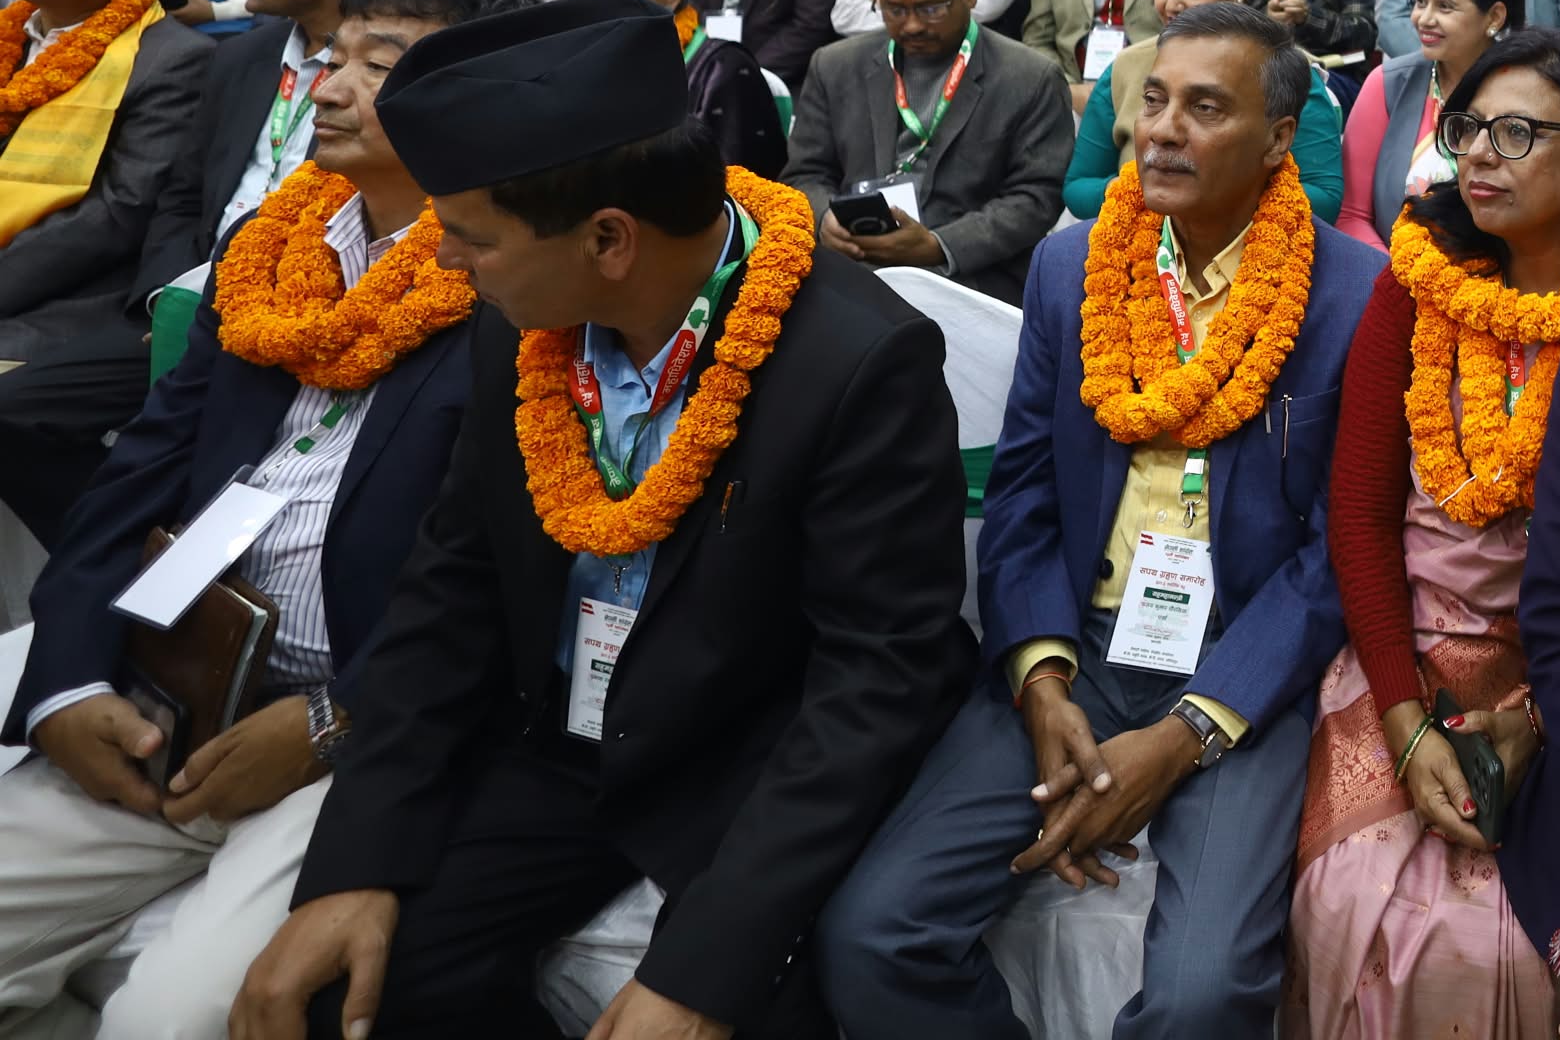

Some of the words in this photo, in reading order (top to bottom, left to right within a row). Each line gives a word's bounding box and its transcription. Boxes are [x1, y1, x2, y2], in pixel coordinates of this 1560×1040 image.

[1166, 279, 1186, 326] महाधिवेशन
[663, 338, 693, 394] महाधिवेशन
[1179, 571, 1207, 587] समारोह
